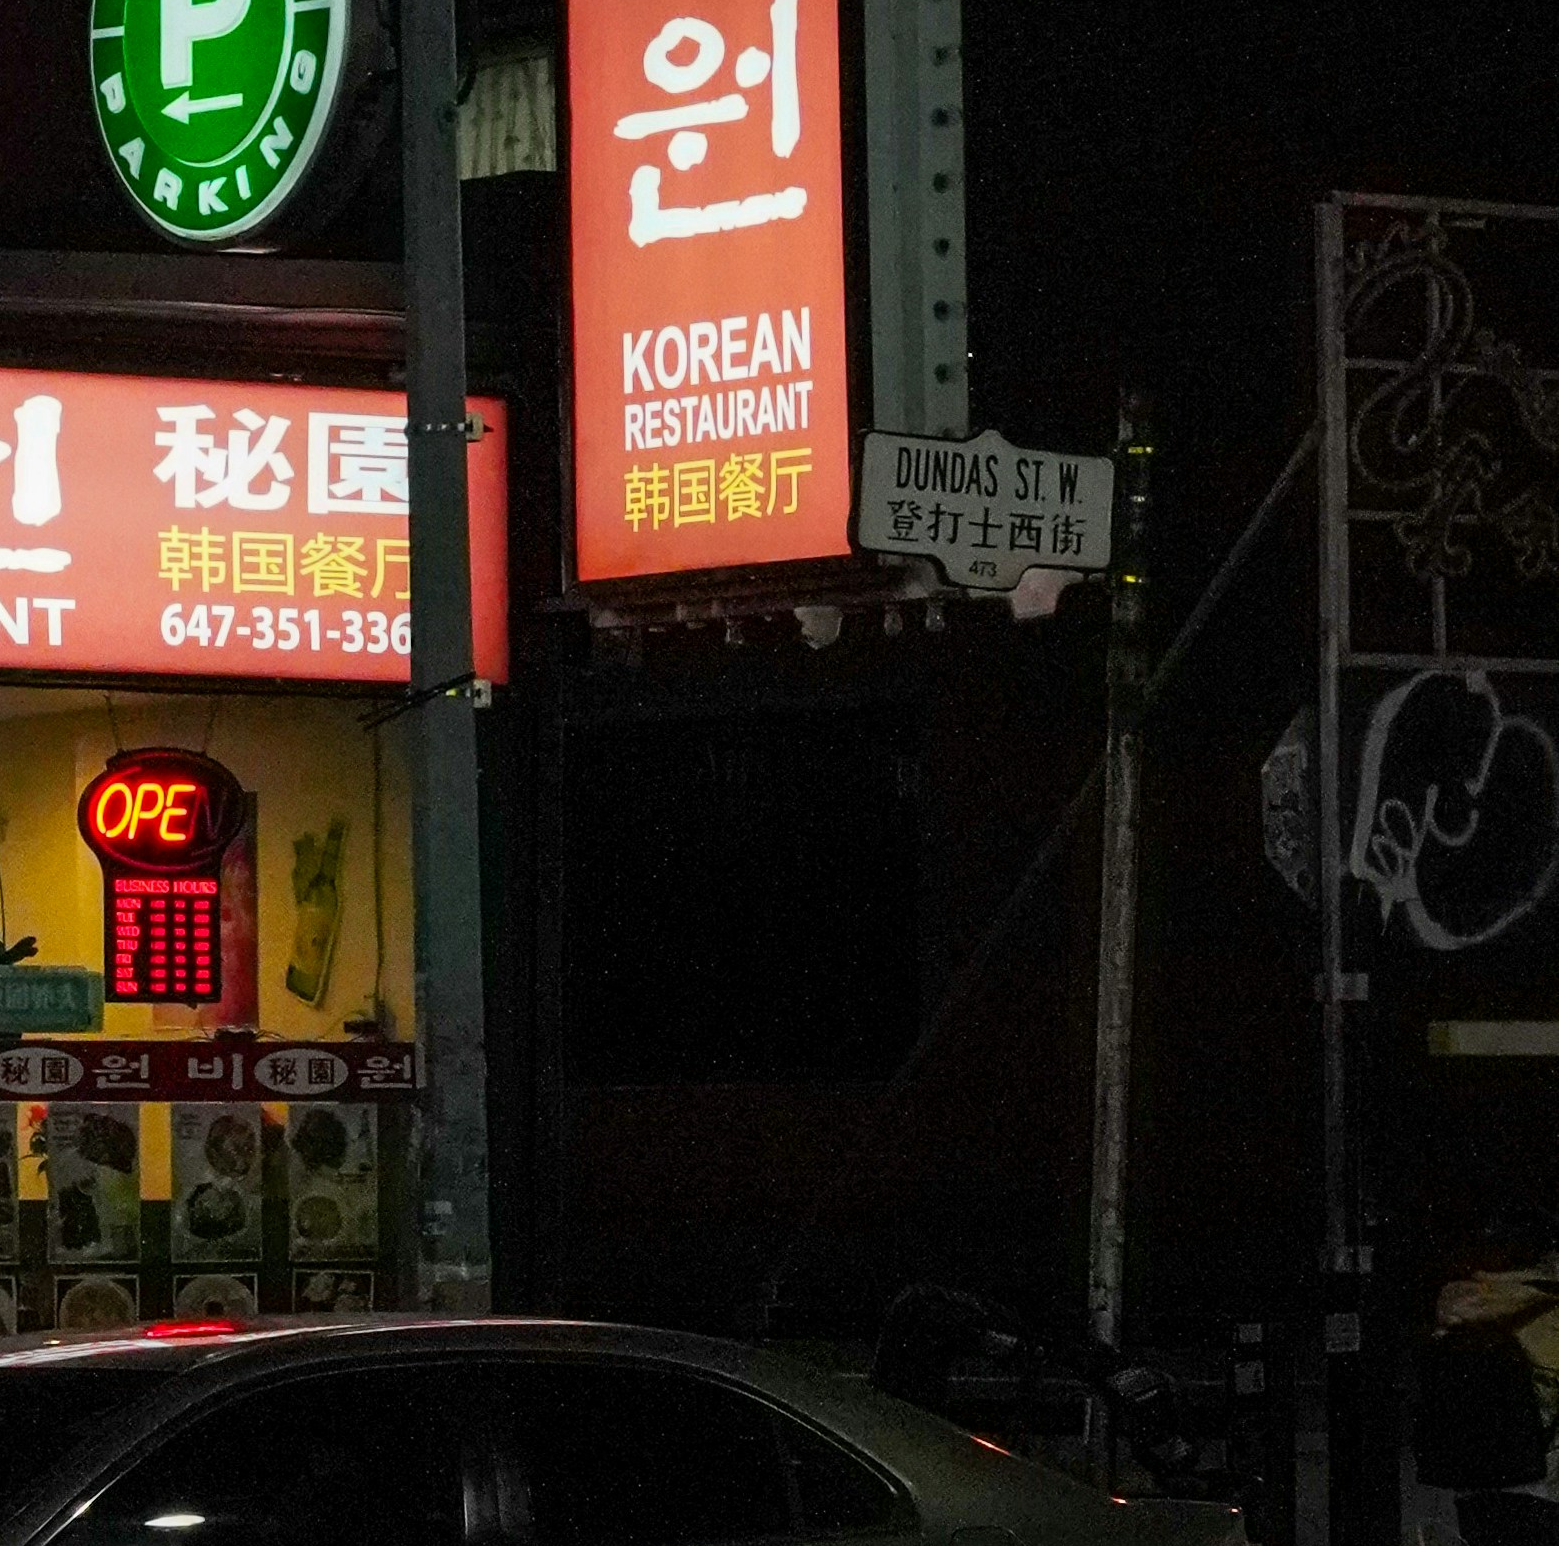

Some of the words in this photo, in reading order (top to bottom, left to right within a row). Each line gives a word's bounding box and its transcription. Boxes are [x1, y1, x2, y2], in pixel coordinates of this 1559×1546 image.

[100, 49, 317, 218] PARKING
[622, 307, 811, 394] KOREAN
[624, 380, 813, 451] RESTAURANT
[153, 403, 410, 515] 秘園
[624, 448, 812, 533] 韩国餐厅
[897, 446, 998, 498] DUNDAS
[1015, 459, 1043, 500] ST.
[1059, 462, 1083, 504] W.
[158, 526, 410, 600] 韩国餐厅
[888, 499, 1086, 556] 登打士西街
[968, 560, 997, 577] 473
[160, 604, 412, 655] 647-351-336
[114, 878, 170, 894] BUSINESS
[172, 879, 218, 894] HOURS
